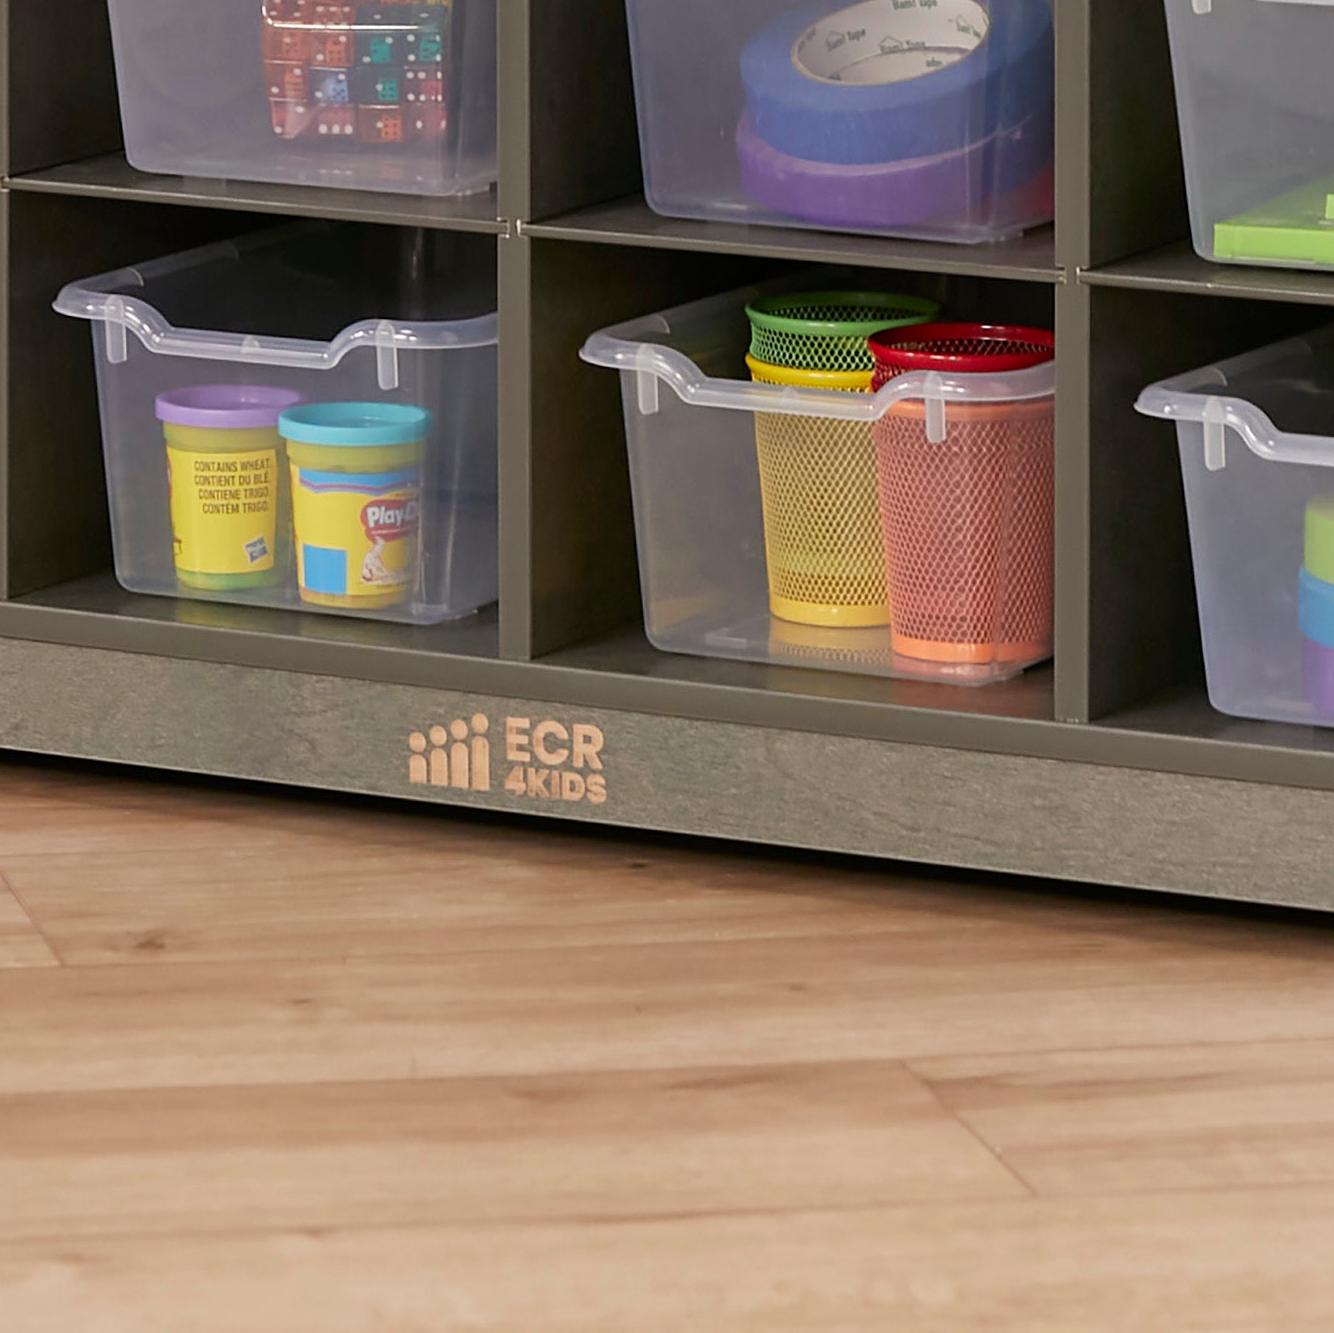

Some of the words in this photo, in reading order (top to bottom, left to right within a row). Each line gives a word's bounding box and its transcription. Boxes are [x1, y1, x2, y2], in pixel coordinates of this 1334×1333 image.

[194, 460, 238, 473] CONTAINS
[194, 474, 236, 487] CONTIENT
[239, 475, 251, 486] DU
[198, 488, 241, 501] CONTIENE
[506, 716, 604, 770] ECR
[504, 766, 607, 804] 4KIDS
